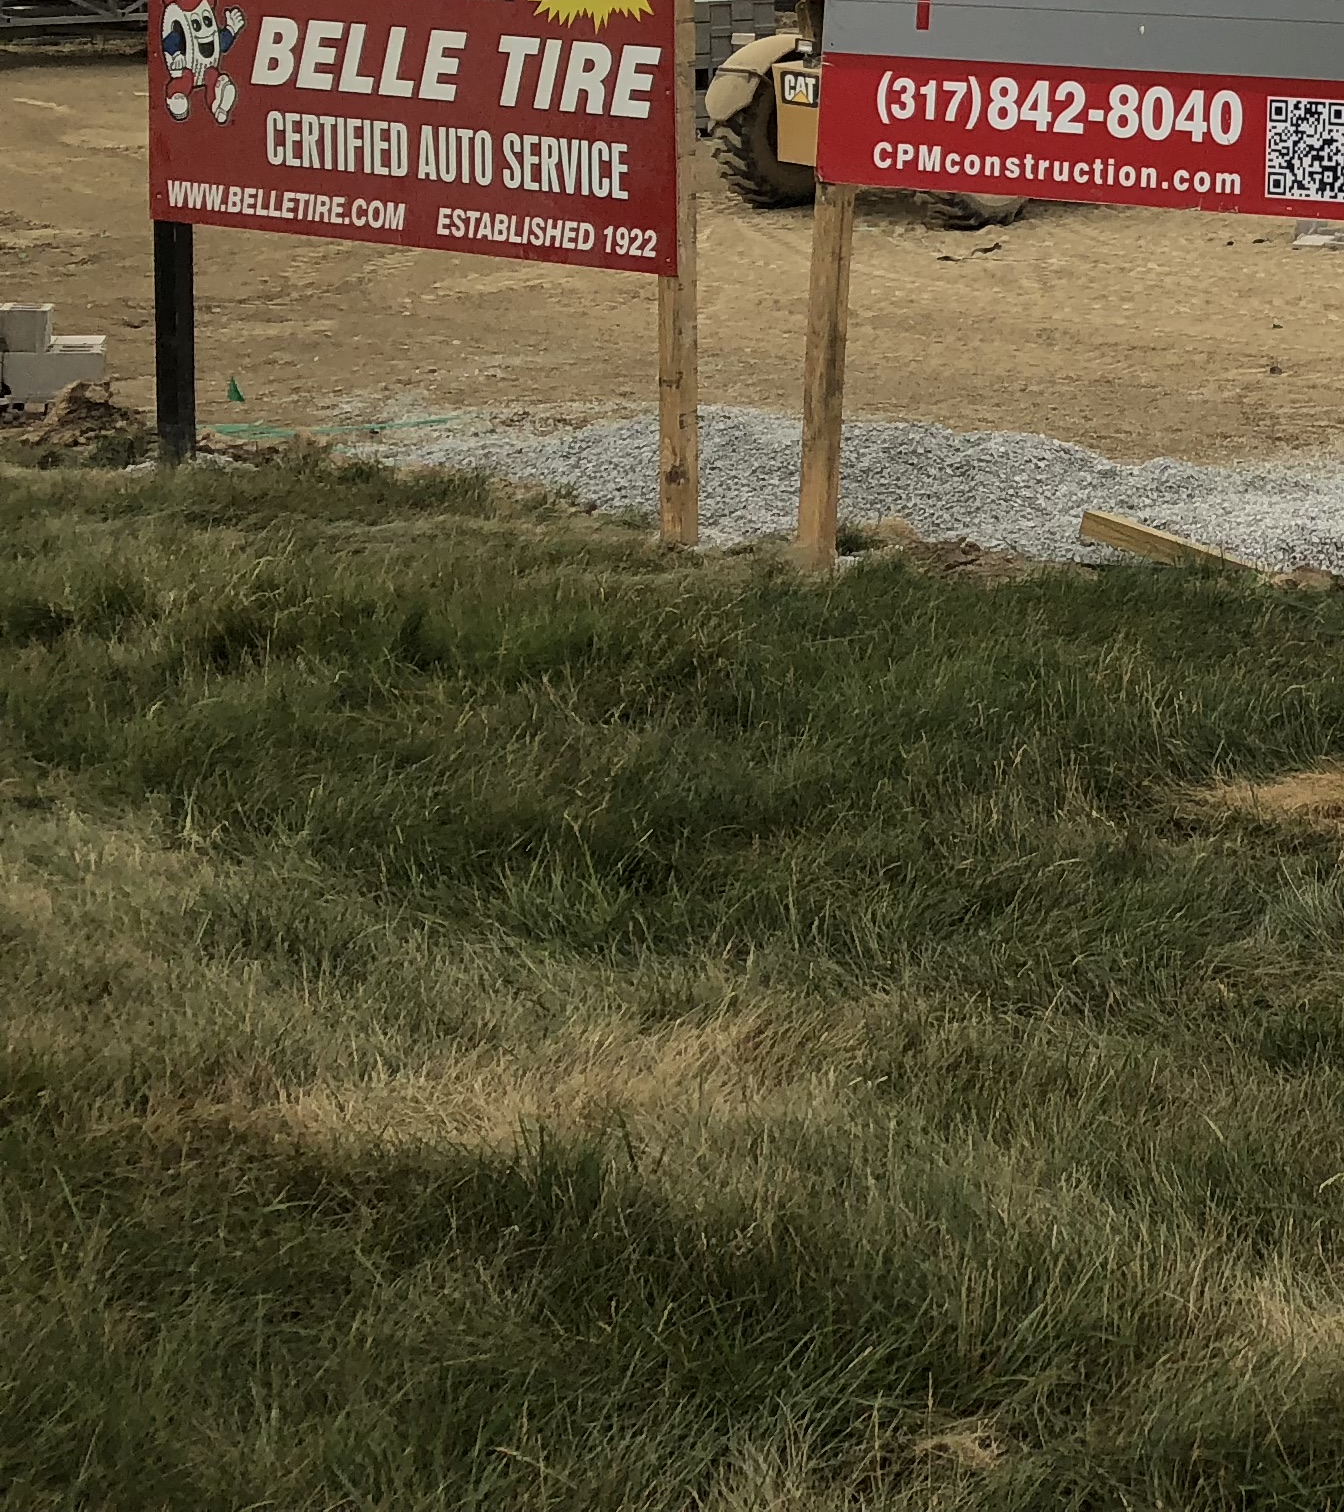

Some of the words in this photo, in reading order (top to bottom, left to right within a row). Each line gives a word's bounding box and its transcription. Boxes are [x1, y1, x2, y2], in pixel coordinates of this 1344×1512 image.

[250, 16, 467, 102] BELLE
[497, 34, 662, 120] TIRE
[784, 74, 816, 103] CAT
[266, 110, 408, 177] CERTIFIED
[418, 124, 493, 186] AUTO
[503, 132, 629, 200] SERVICE
[873, 141, 1241, 195] CPMconstruction.com
[167, 179, 406, 231] WWW.BELLETIRE.COM
[436, 207, 594, 251] ESTABLISHED
[602, 225, 658, 258] 1922
